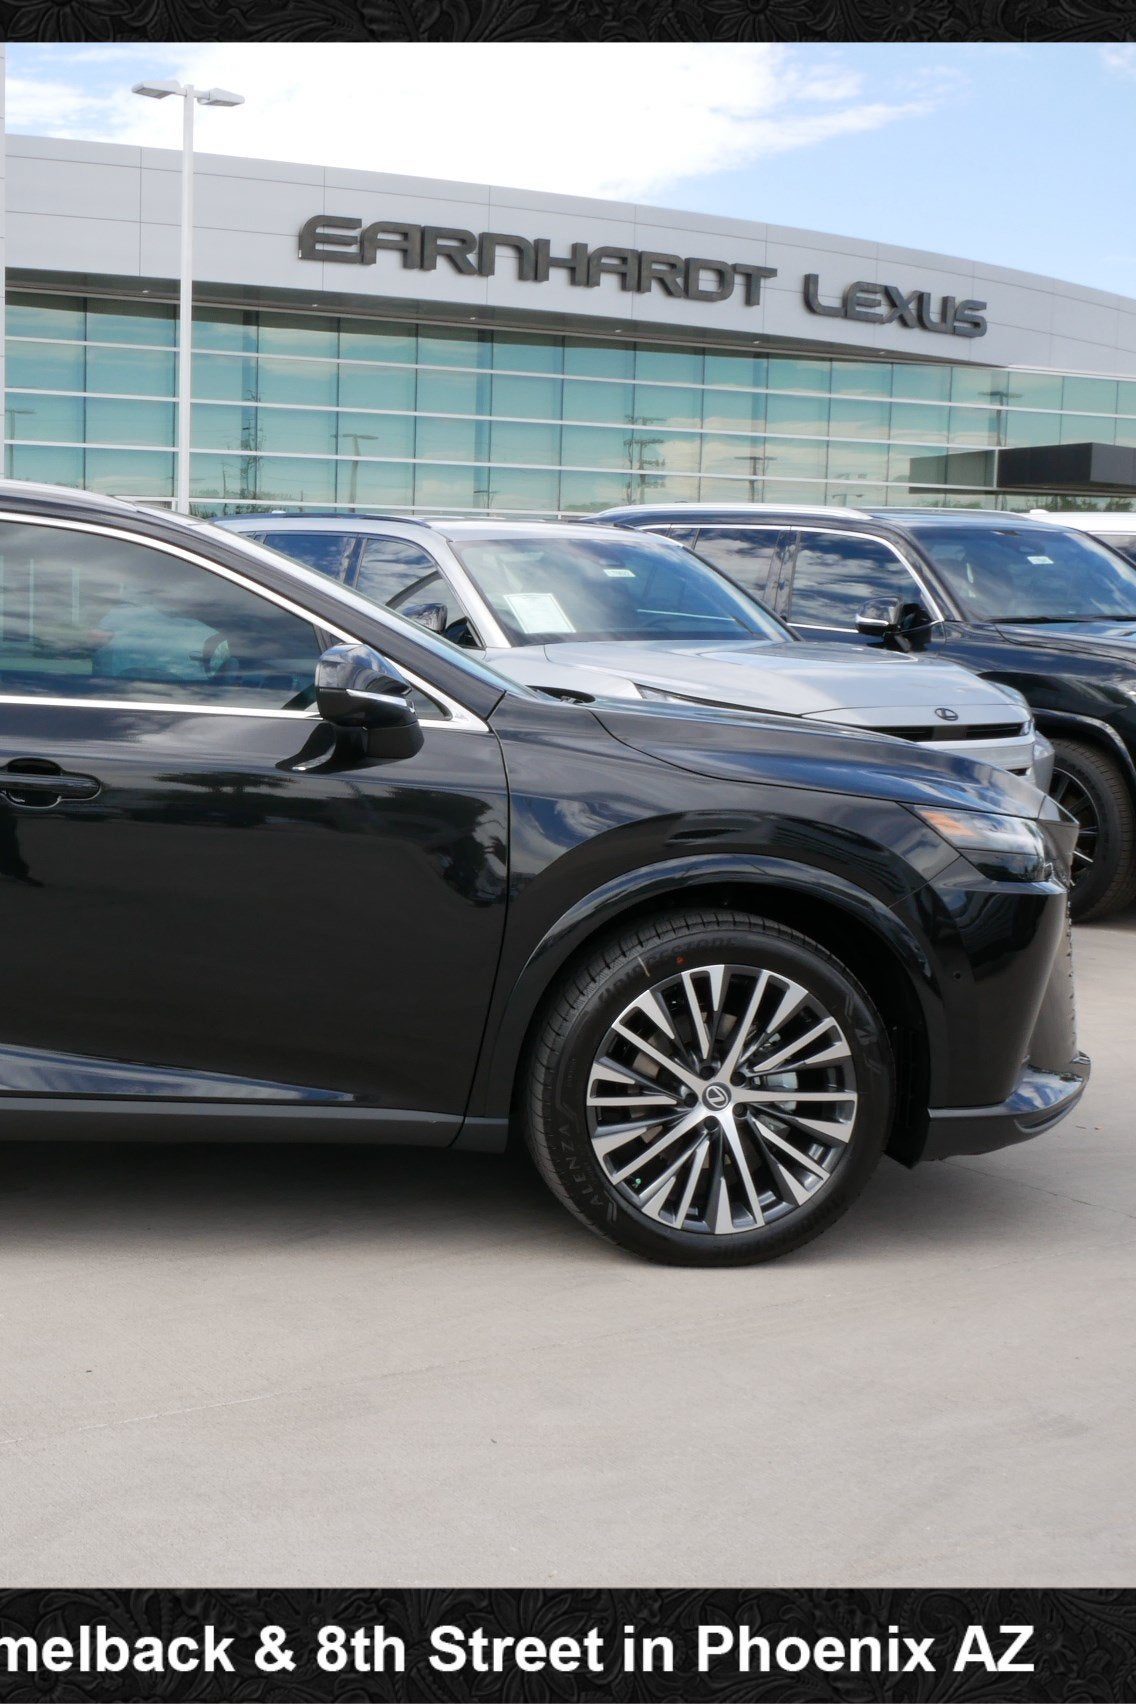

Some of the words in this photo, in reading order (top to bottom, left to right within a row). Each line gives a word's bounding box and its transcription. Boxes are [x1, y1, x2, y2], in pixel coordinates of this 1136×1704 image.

[298, 214, 778, 307] EARNHARDT
[803, 273, 988, 338] LEXUS
[558, 1123, 605, 1207] ALENZA
